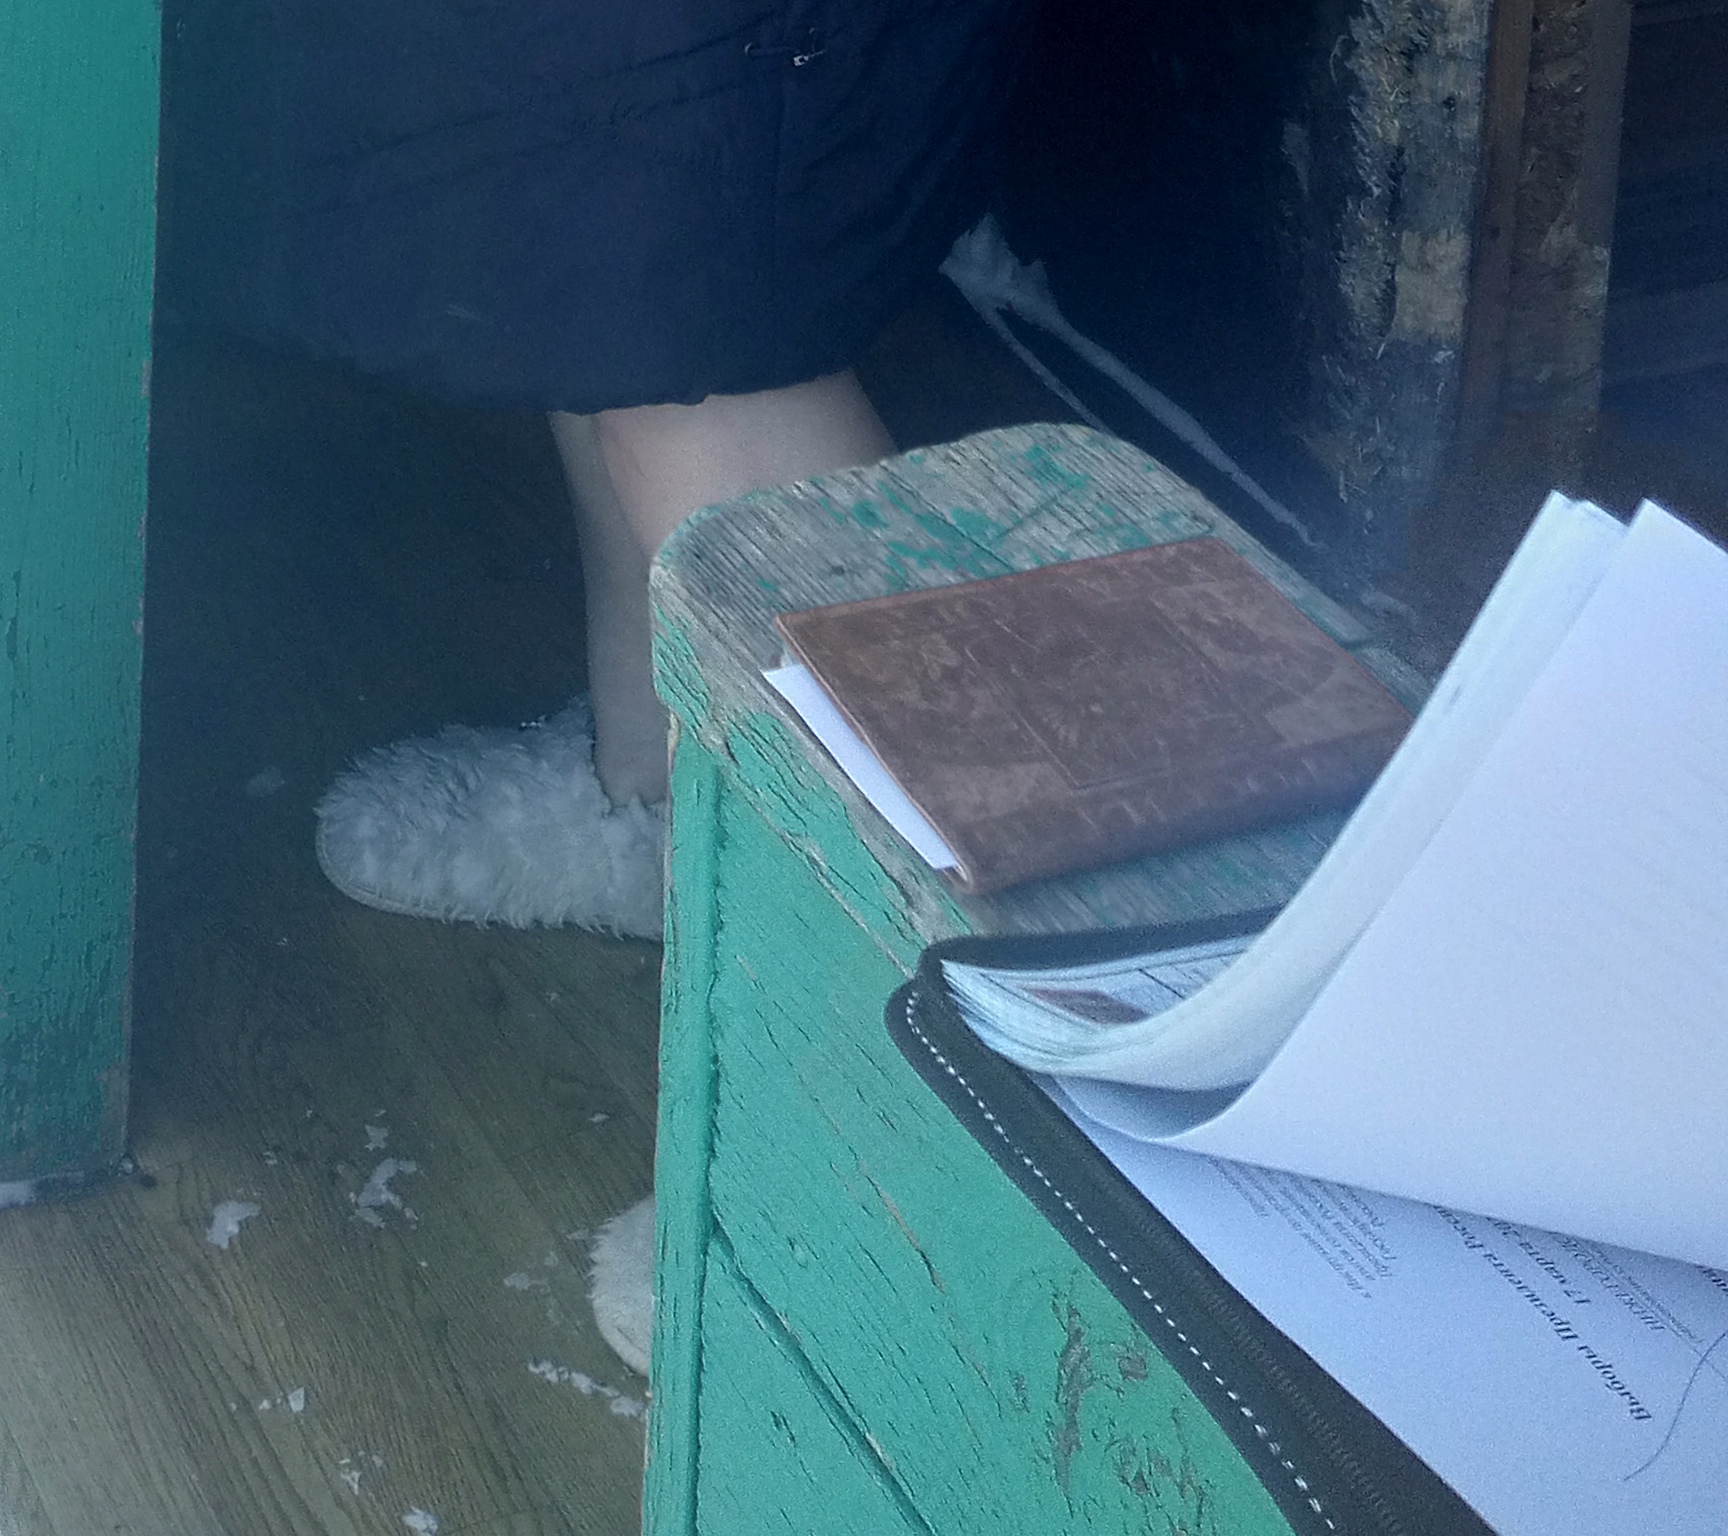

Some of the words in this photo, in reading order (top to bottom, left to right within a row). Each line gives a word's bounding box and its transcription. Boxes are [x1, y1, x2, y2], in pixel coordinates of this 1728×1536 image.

[1433, 1205, 1484, 1249] Росси
[1519, 1241, 1574, 1284] марта
[1484, 1251, 1579, 1341] Президента
[1563, 1289, 1592, 1304] 17
[1578, 1344, 1652, 1420] Выборы
